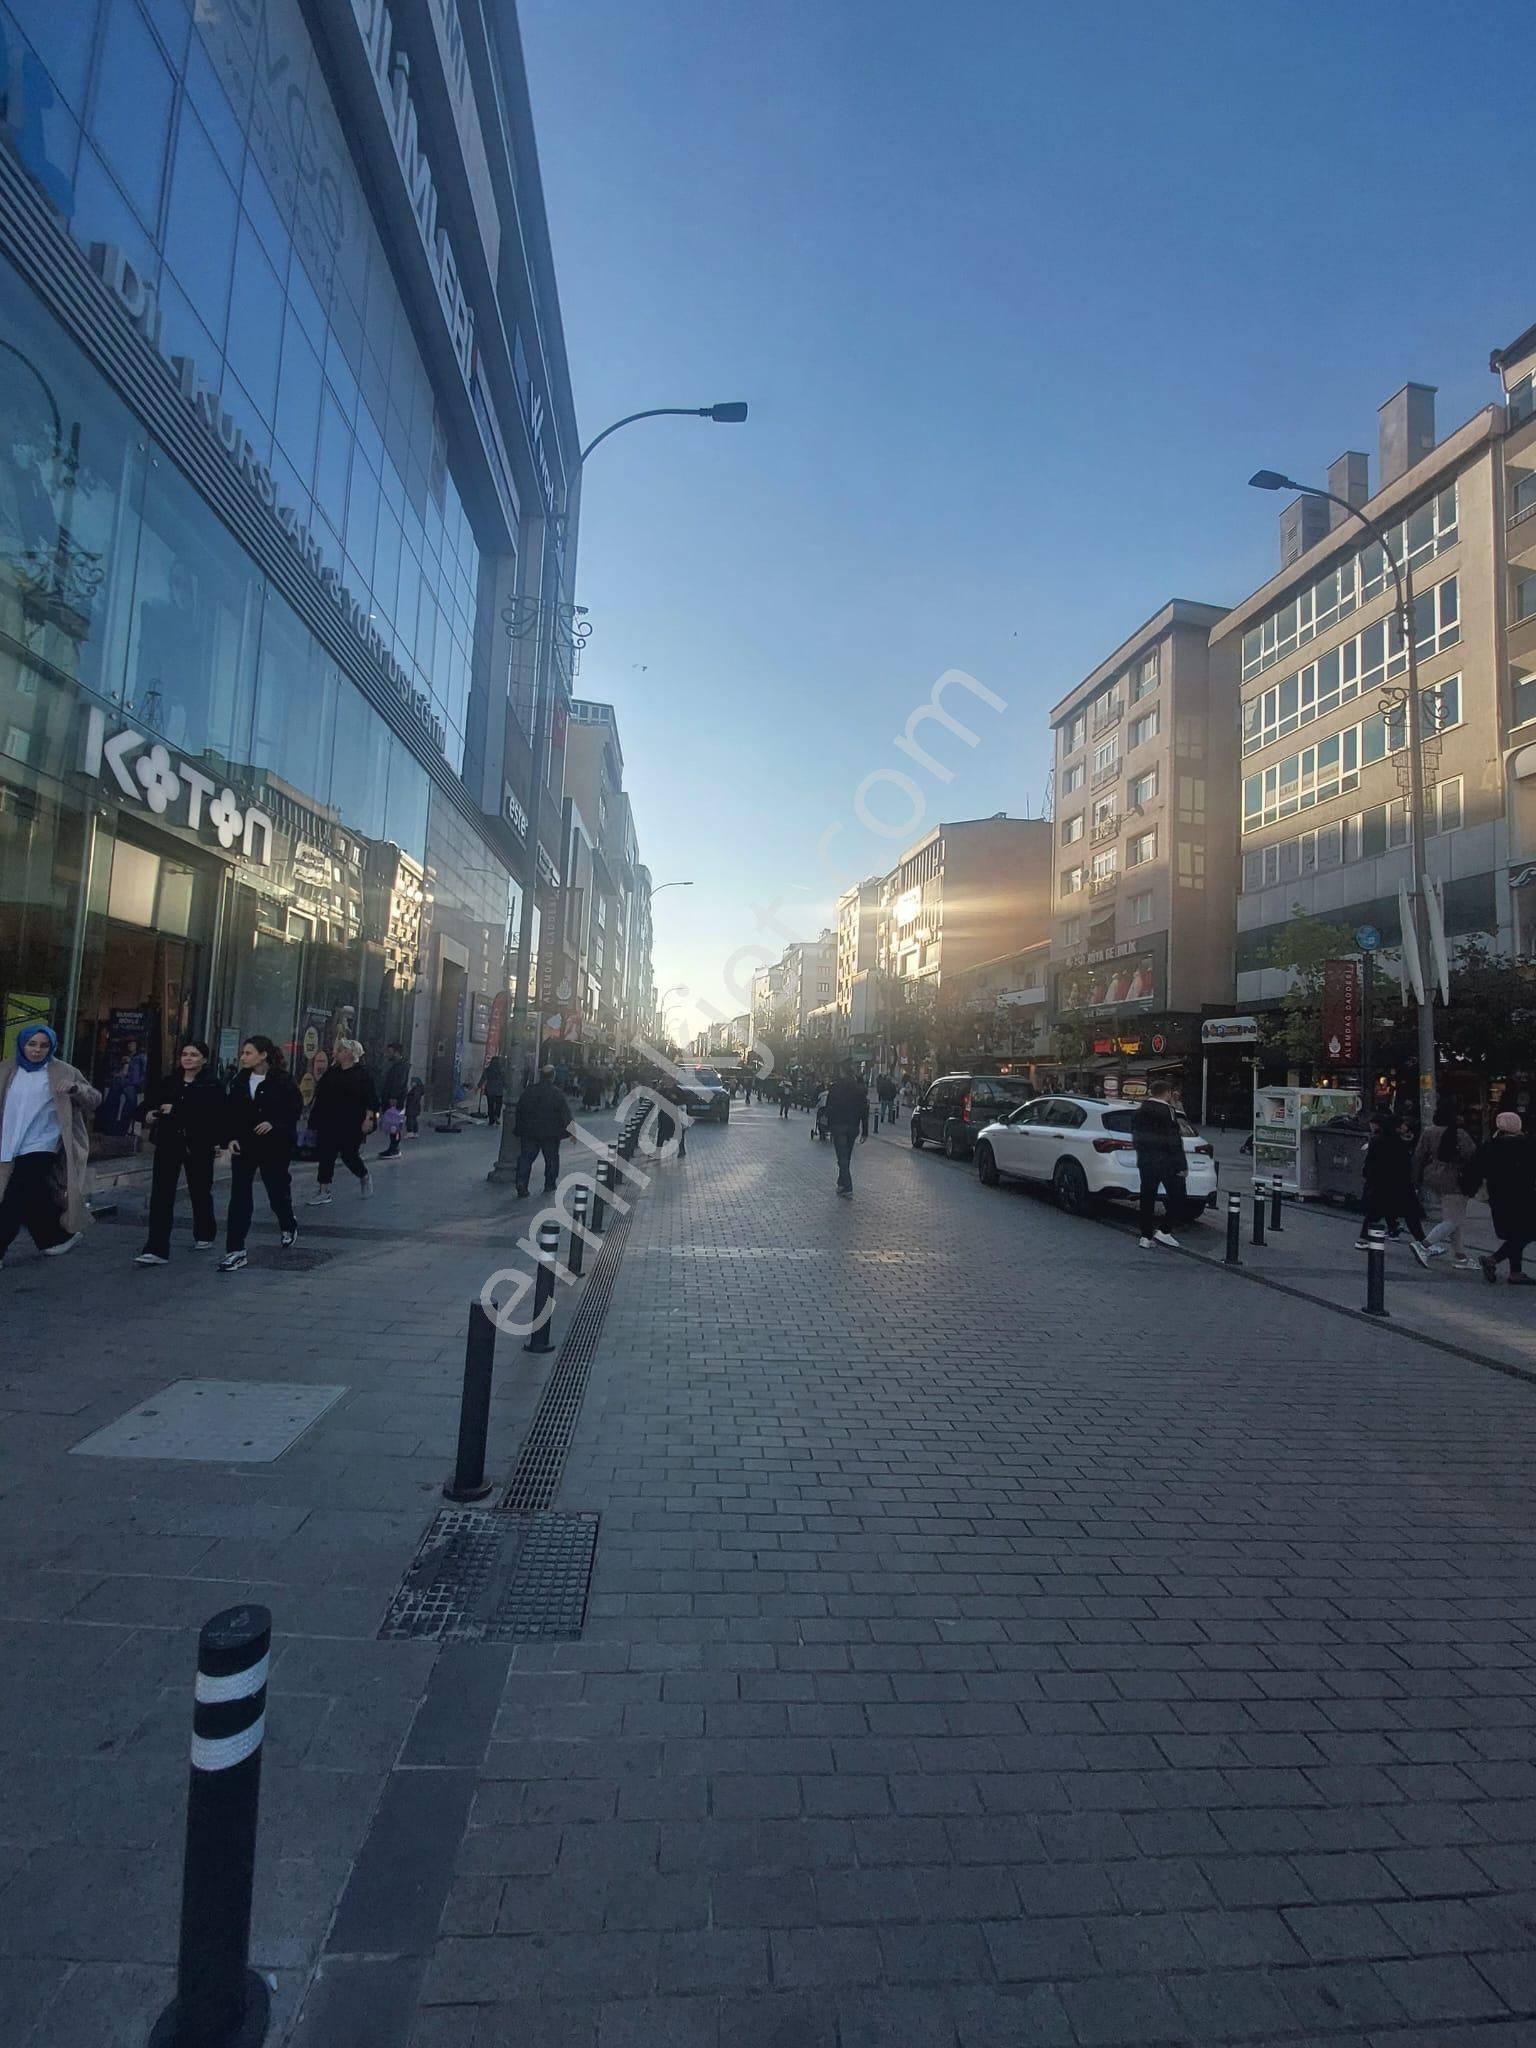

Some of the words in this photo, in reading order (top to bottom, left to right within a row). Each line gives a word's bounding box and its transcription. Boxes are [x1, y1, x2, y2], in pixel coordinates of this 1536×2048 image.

[89, 241, 179, 379] DİL
[171, 355, 323, 580] KURSLARI
[340, 588, 390, 666] YURT
[413, 684, 447, 756] EĞİTİM
